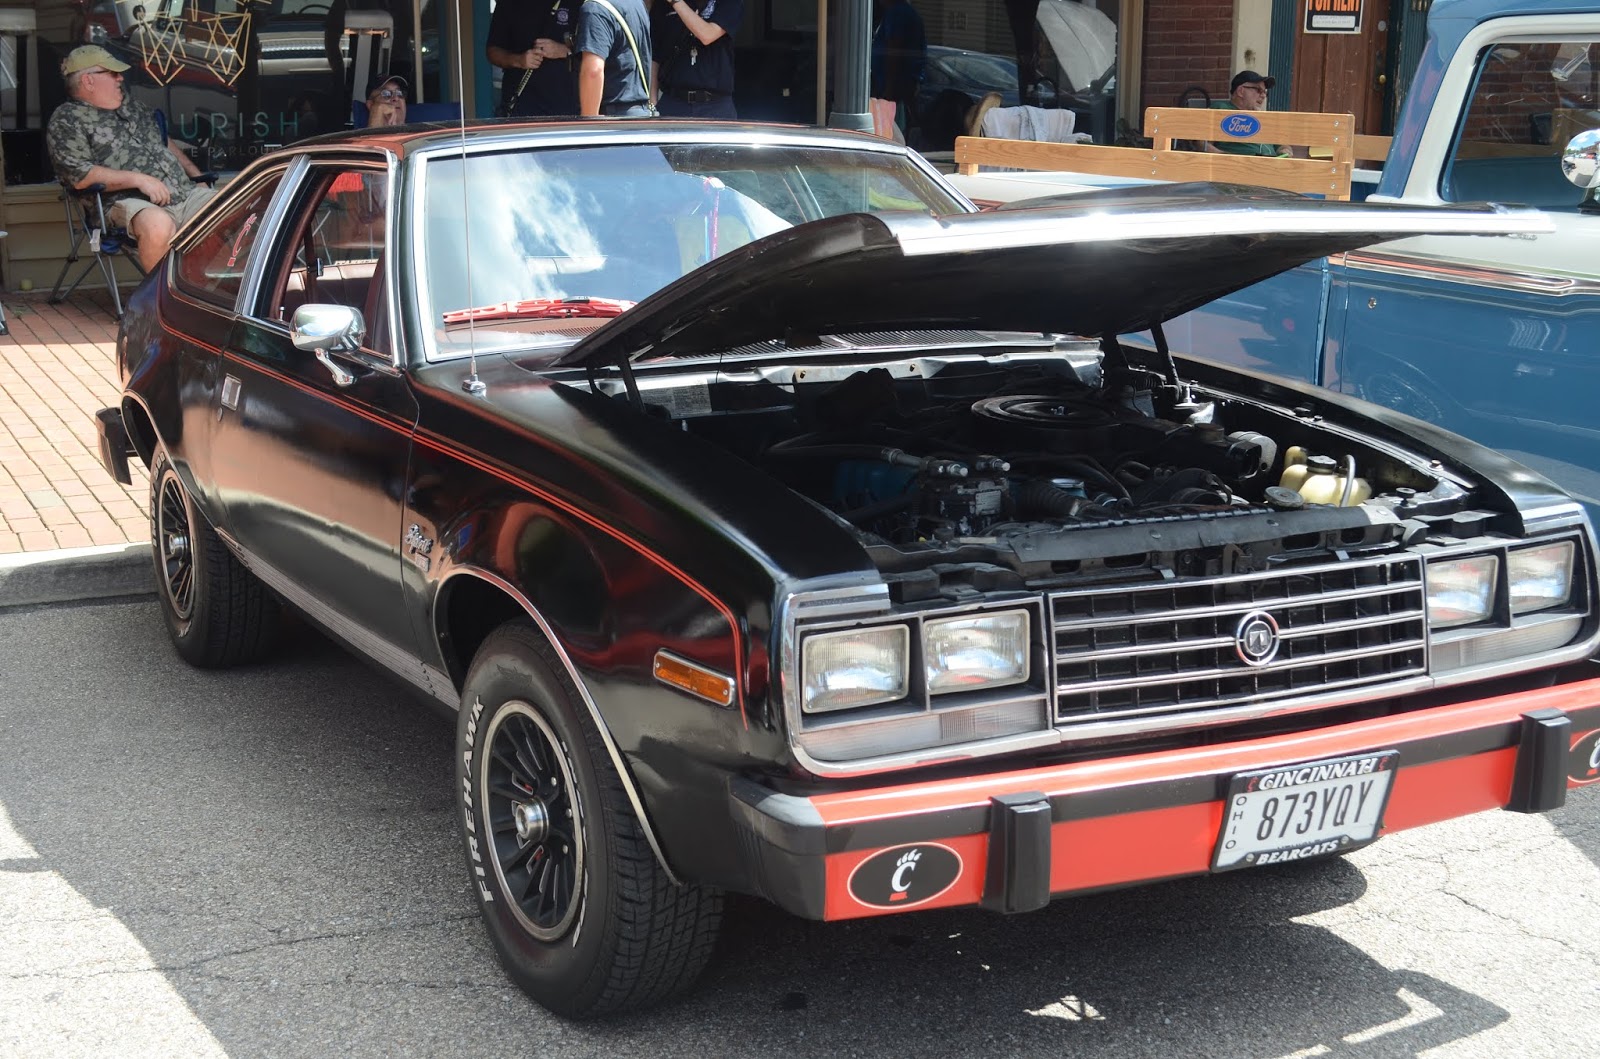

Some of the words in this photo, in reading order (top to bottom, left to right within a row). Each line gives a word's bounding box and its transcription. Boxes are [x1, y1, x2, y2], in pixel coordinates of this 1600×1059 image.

[1228, 116, 1253, 133] Ford
[1258, 757, 1378, 791] CINCINNATI
[463, 696, 494, 902] FIREHAWK
[1256, 779, 1375, 841] 873YQY
[1256, 839, 1340, 866] BEARCATS
